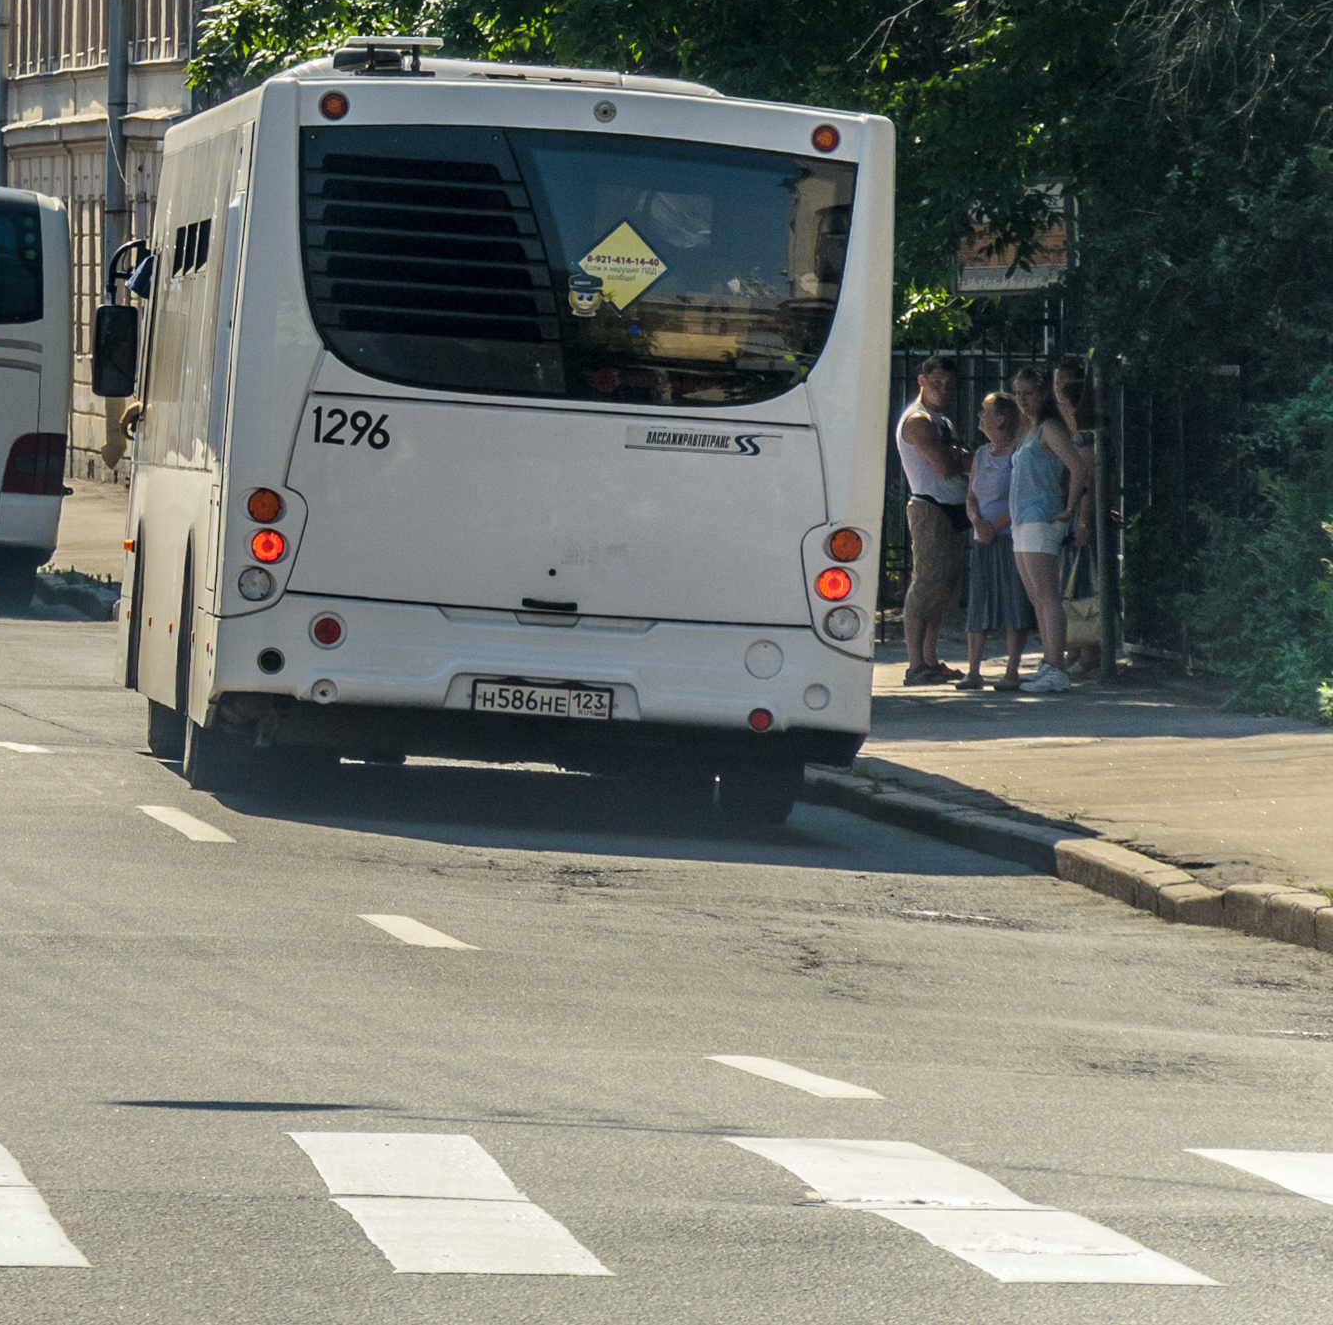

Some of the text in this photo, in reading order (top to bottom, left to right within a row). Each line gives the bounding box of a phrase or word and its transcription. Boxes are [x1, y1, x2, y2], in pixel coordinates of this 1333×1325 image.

[584, 263, 602, 272] Если
[587, 254, 660, 266] 8-921-414-14-40
[312, 405, 391, 450] 1296
[645, 431, 731, 449] ПАССАЖИРАВТОТРАНС
[482, 687, 604, 714] Н586НЕ 123
